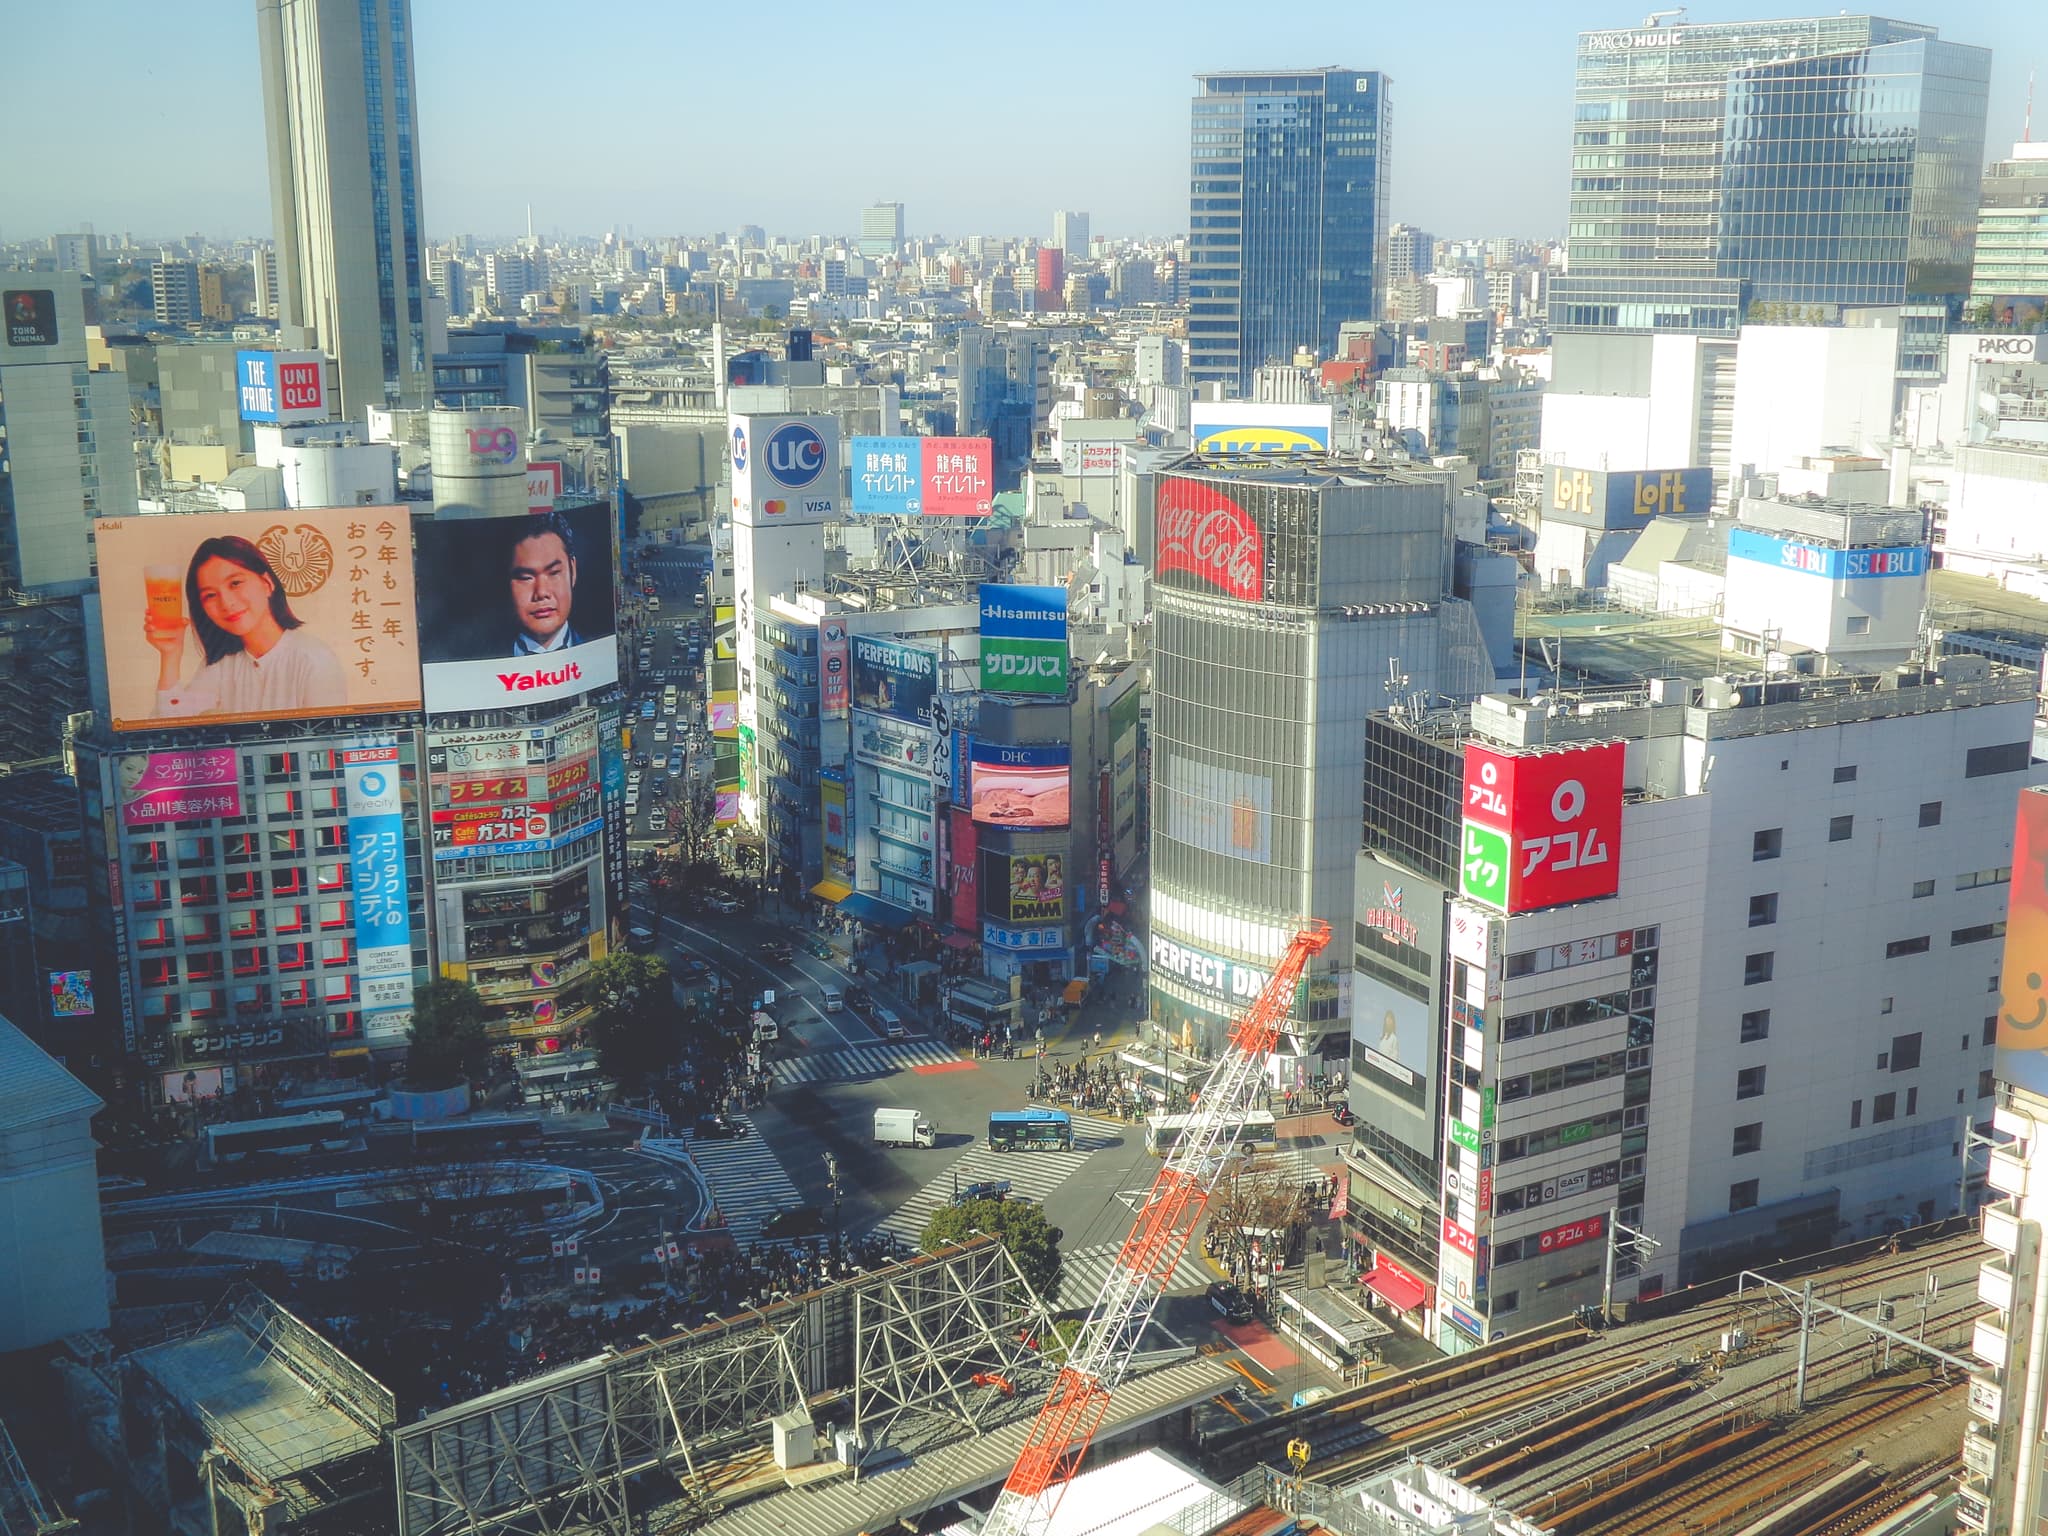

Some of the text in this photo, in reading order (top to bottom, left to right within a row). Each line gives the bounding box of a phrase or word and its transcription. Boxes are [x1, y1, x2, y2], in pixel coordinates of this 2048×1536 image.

[1588, 32, 1682, 51] PARCO HULIC
[1978, 338, 2034, 355] PARCO
[246, 360, 267, 387] THE
[284, 367, 312, 385] UNI
[242, 386, 274, 413] PRIME
[284, 386, 317, 405] QLO
[866, 453, 907, 473] 龍角散
[936, 453, 978, 474] 龍角散
[804, 501, 832, 512] VISA
[1781, 543, 1827, 575] SEIBU
[1847, 550, 1913, 575] SEIBU
[347, 522, 378, 686] おつかれ生です。
[981, 605, 1066, 621] Hisamitsu
[858, 641, 900, 667] PERFECT
[904, 651, 932, 674] DAYS
[985, 653, 1061, 678] サロンパス
[496, 662, 582, 692] Yakult
[171, 755, 230, 770] 品川スキン
[430, 754, 446, 765] 9F
[1001, 750, 1030, 763] DHC
[173, 768, 225, 783] クリニック
[140, 797, 234, 818] 品川美容外科
[1469, 784, 1507, 817] アコム
[501, 805, 537, 820] ガスト
[434, 830, 452, 841] 7F
[478, 822, 522, 841] ガスト
[1522, 828, 1609, 878] アコム
[356, 834, 380, 927] アイシティ
[381, 831, 402, 925] コンタクトの
[1365, 908, 1418, 948] MAGNET
[1152, 933, 1226, 990] PERFECT
[1453, 1124, 1479, 1146] レイク
[1557, 1222, 1600, 1244] アコム 3F
